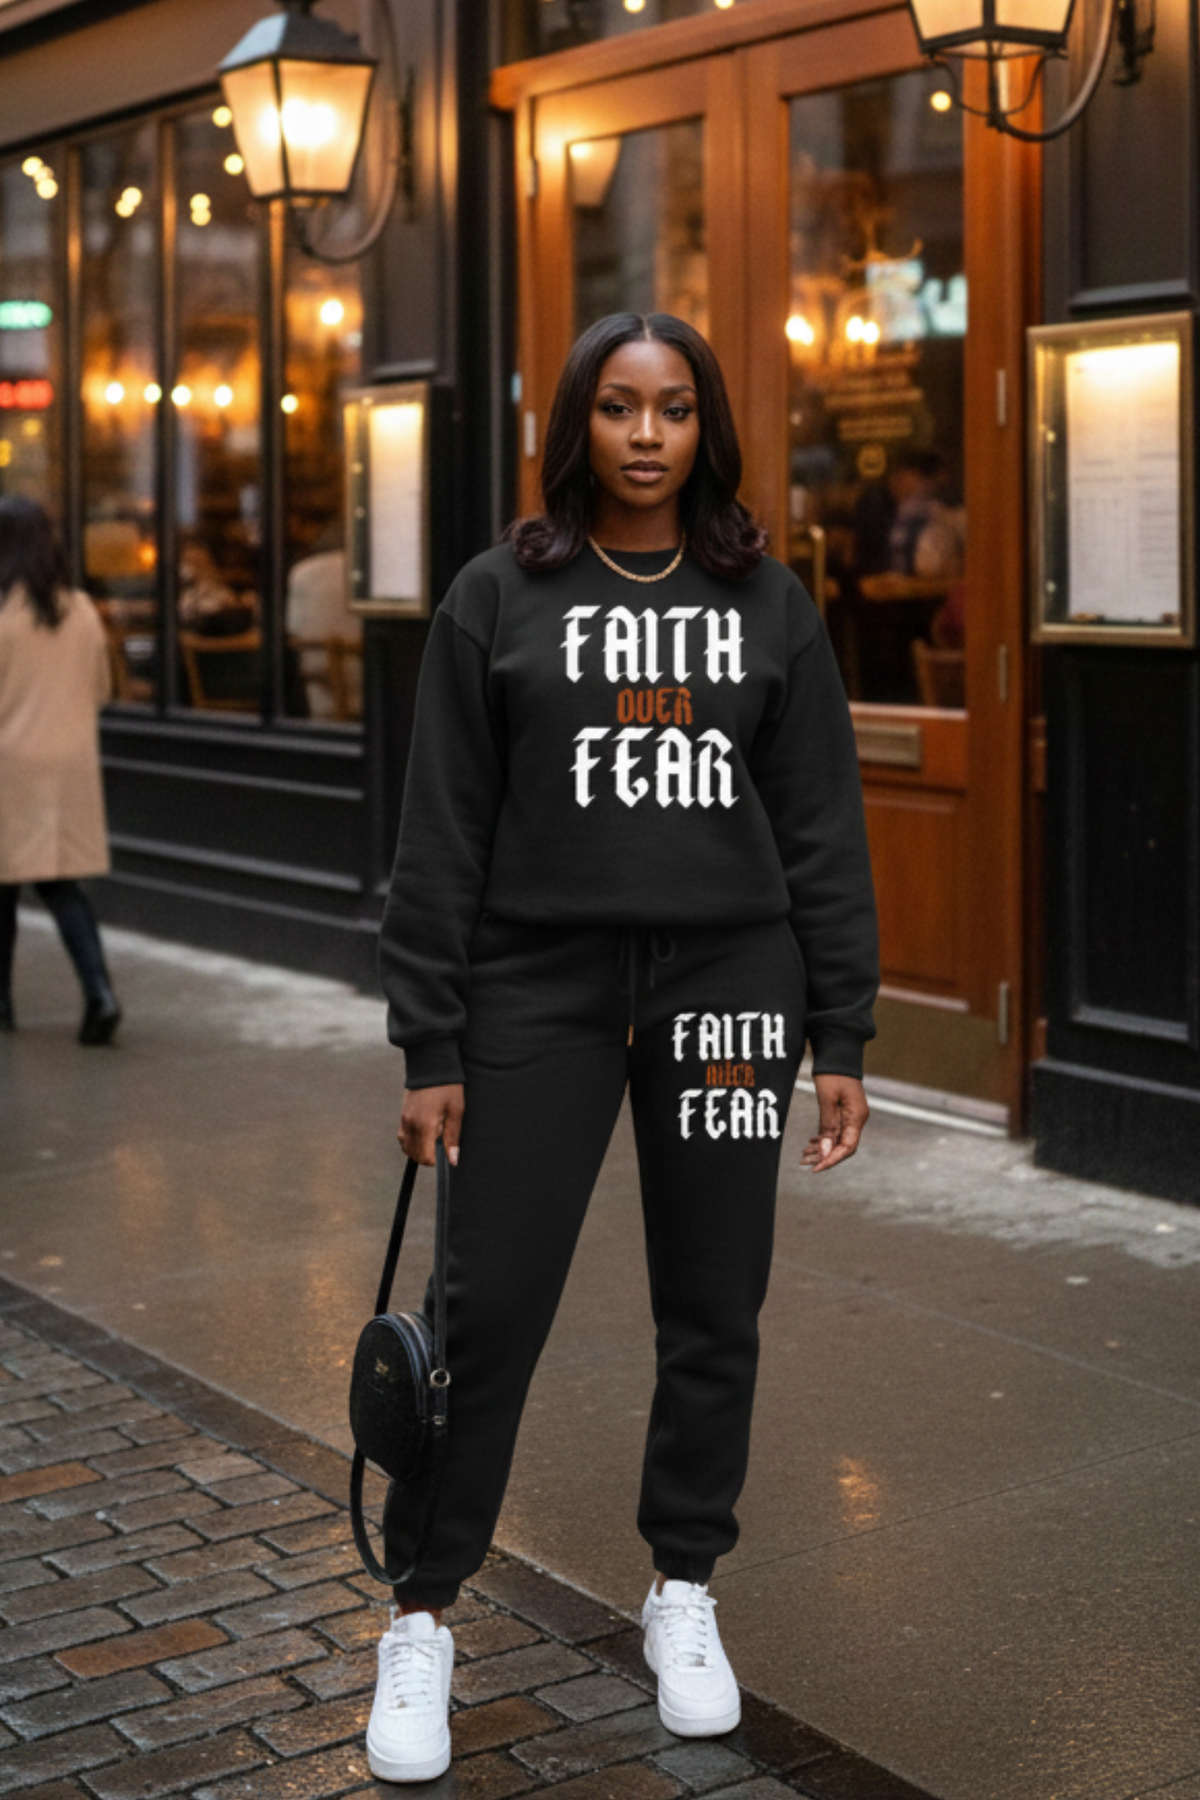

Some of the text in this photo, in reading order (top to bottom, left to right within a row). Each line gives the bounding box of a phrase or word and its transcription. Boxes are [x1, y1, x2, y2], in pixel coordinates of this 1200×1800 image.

[560, 605, 748, 683] FAITH
[569, 726, 739, 808] FEAR
[671, 1011, 787, 1062] FAITH
[678, 1087, 782, 1141] FEAR
